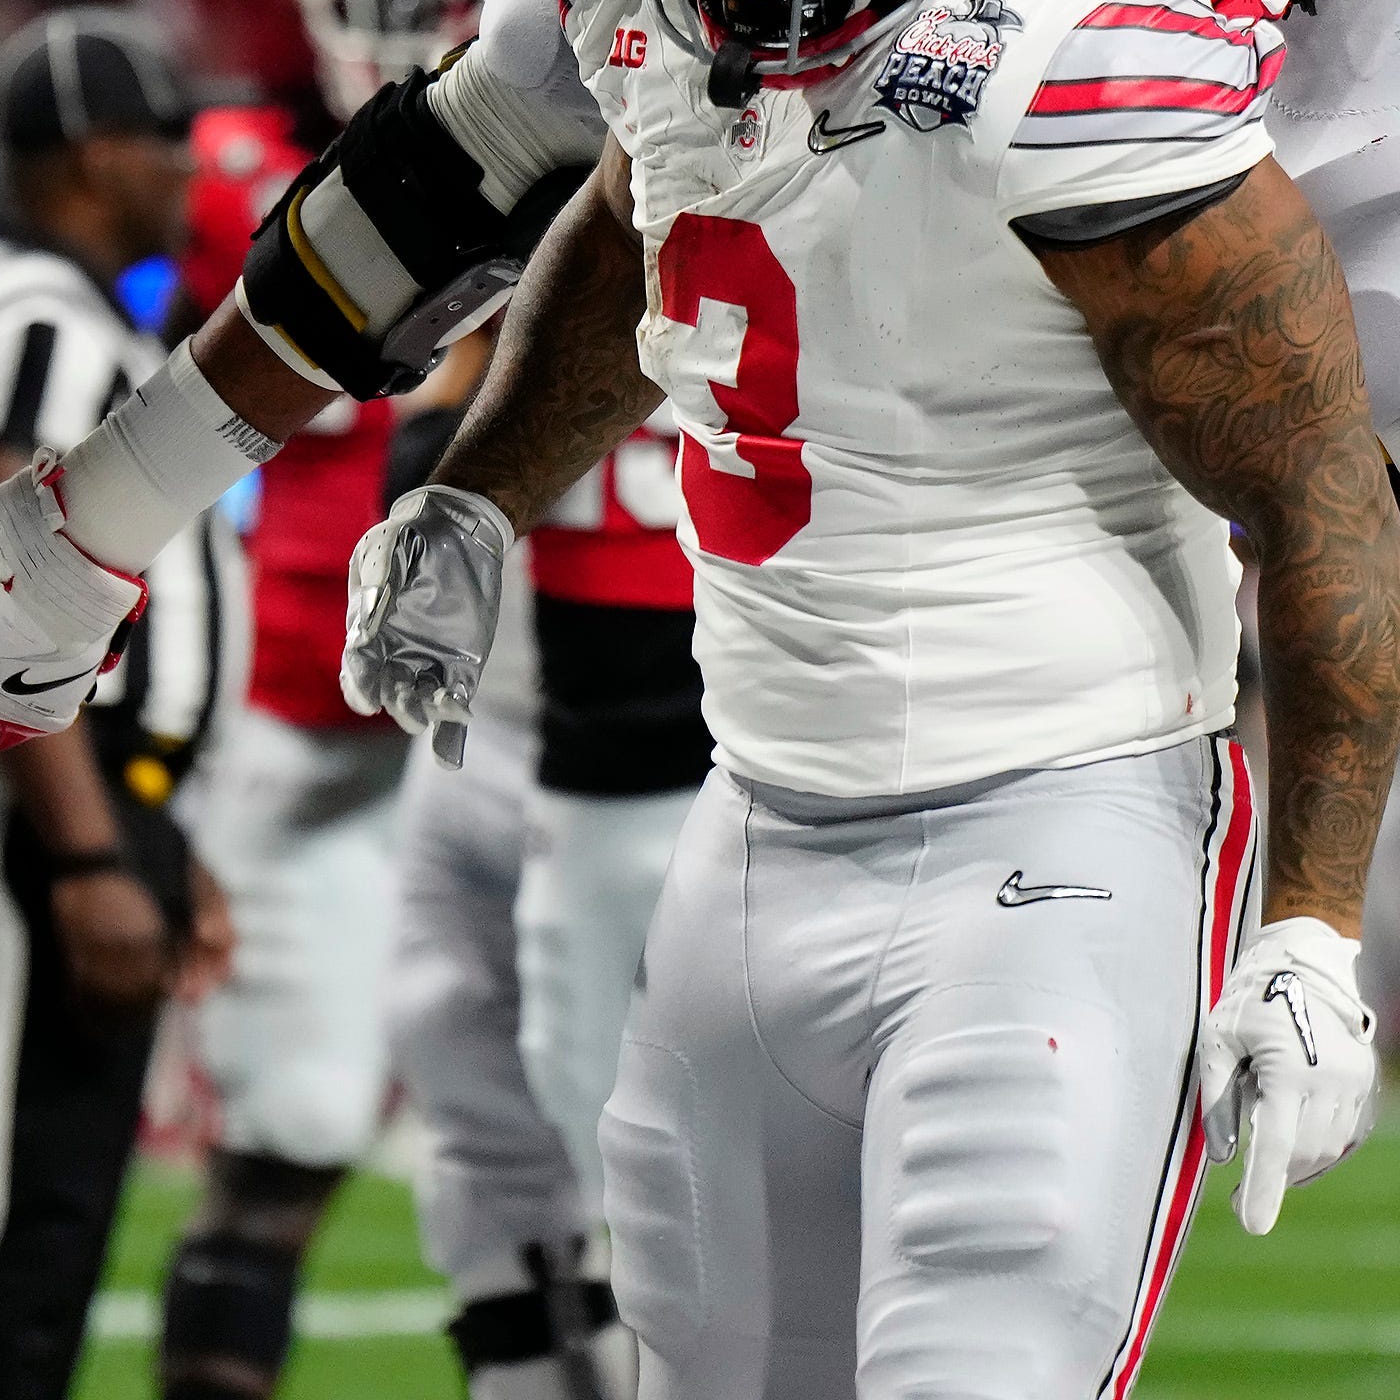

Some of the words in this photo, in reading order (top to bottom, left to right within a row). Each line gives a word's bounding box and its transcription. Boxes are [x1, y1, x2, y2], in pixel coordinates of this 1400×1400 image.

[898, 8, 1002, 67] Chick-fil-A
[877, 52, 989, 108] PEACH
[894, 87, 952, 112] BOWL
[656, 212, 813, 567] 3
